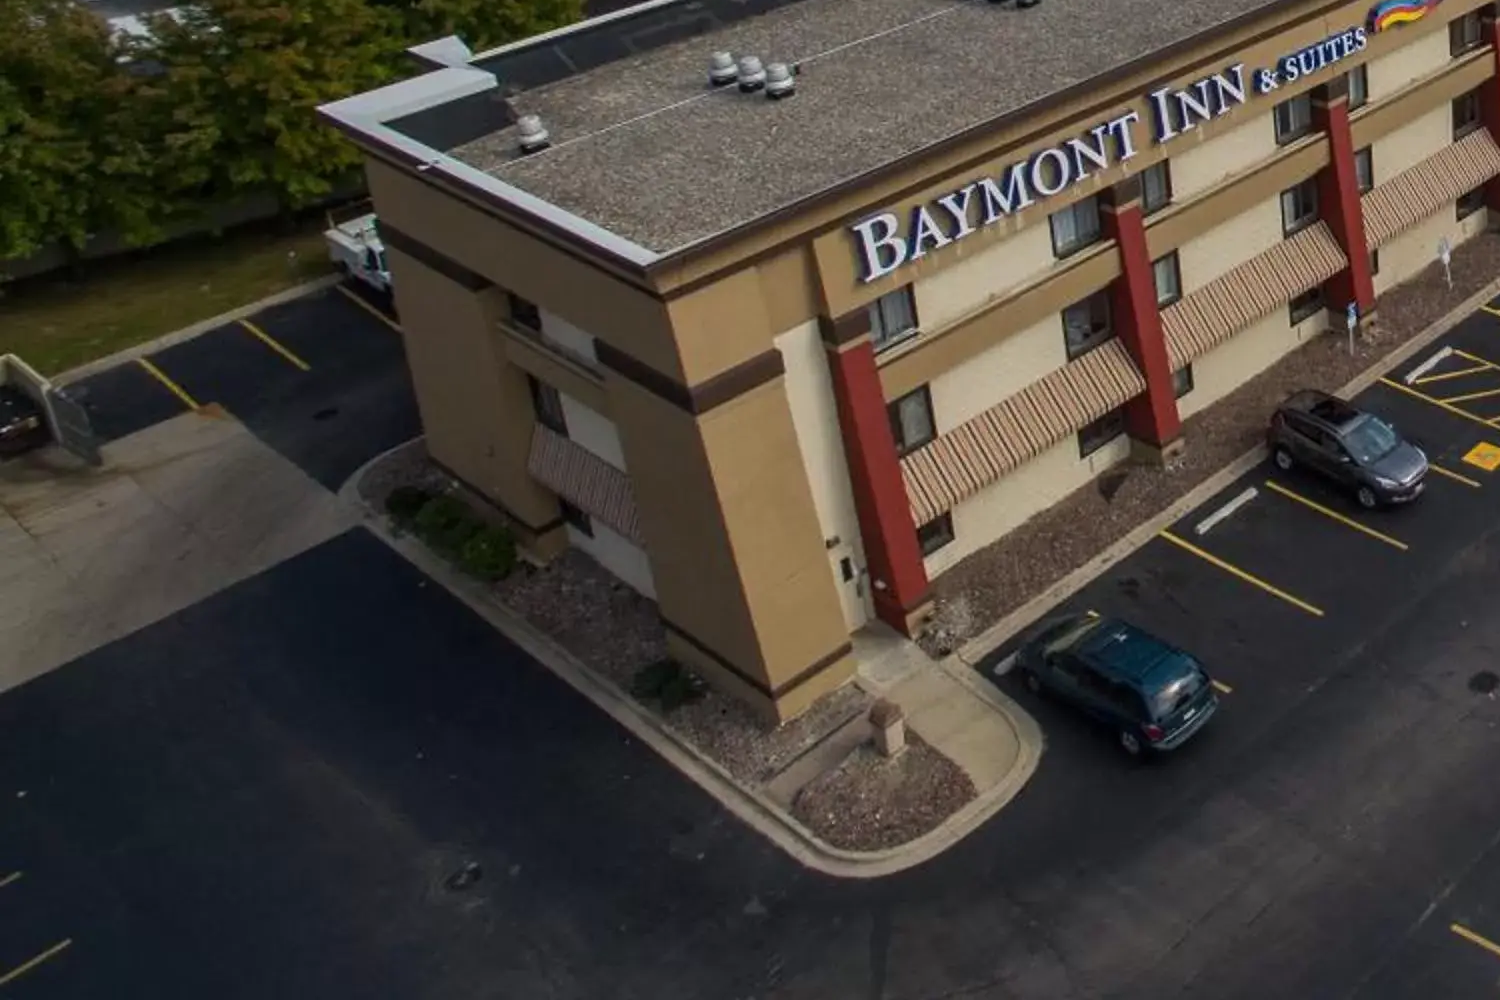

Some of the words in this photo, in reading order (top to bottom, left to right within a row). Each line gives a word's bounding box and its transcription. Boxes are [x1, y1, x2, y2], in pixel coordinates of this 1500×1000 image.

[853, 111, 1139, 283] BAYMONT
[1151, 63, 1245, 143] INN
[1260, 68, 1279, 93] &
[1285, 26, 1368, 82] SUITES
